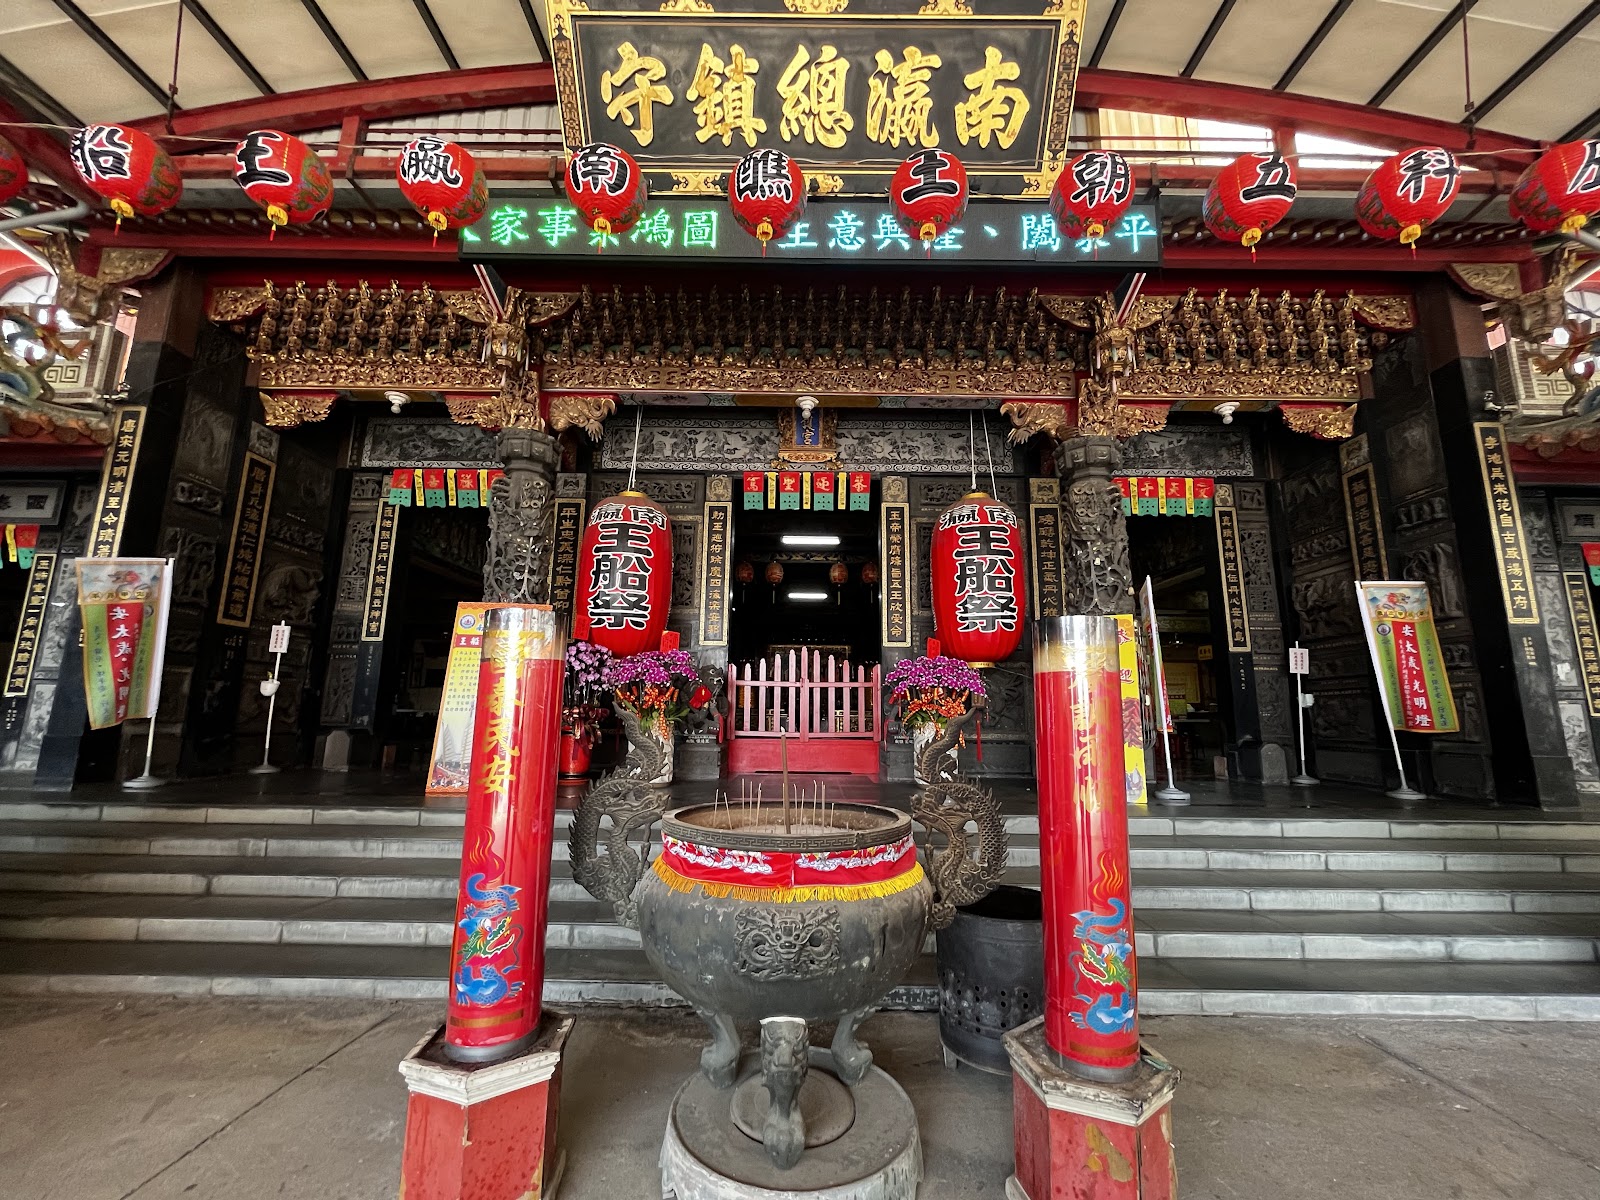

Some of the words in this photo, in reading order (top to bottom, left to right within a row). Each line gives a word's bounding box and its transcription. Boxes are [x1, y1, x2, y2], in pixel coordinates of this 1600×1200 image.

[235, 130, 293, 188] 王
[571, 143, 631, 195] 南
[735, 149, 793, 203] 醮
[902, 148, 961, 206] 王
[1071, 152, 1131, 208] 朝
[1397, 147, 1461, 204] 科
[587, 521, 655, 630] 王船祭
[952, 524, 1018, 632] 王船祭
